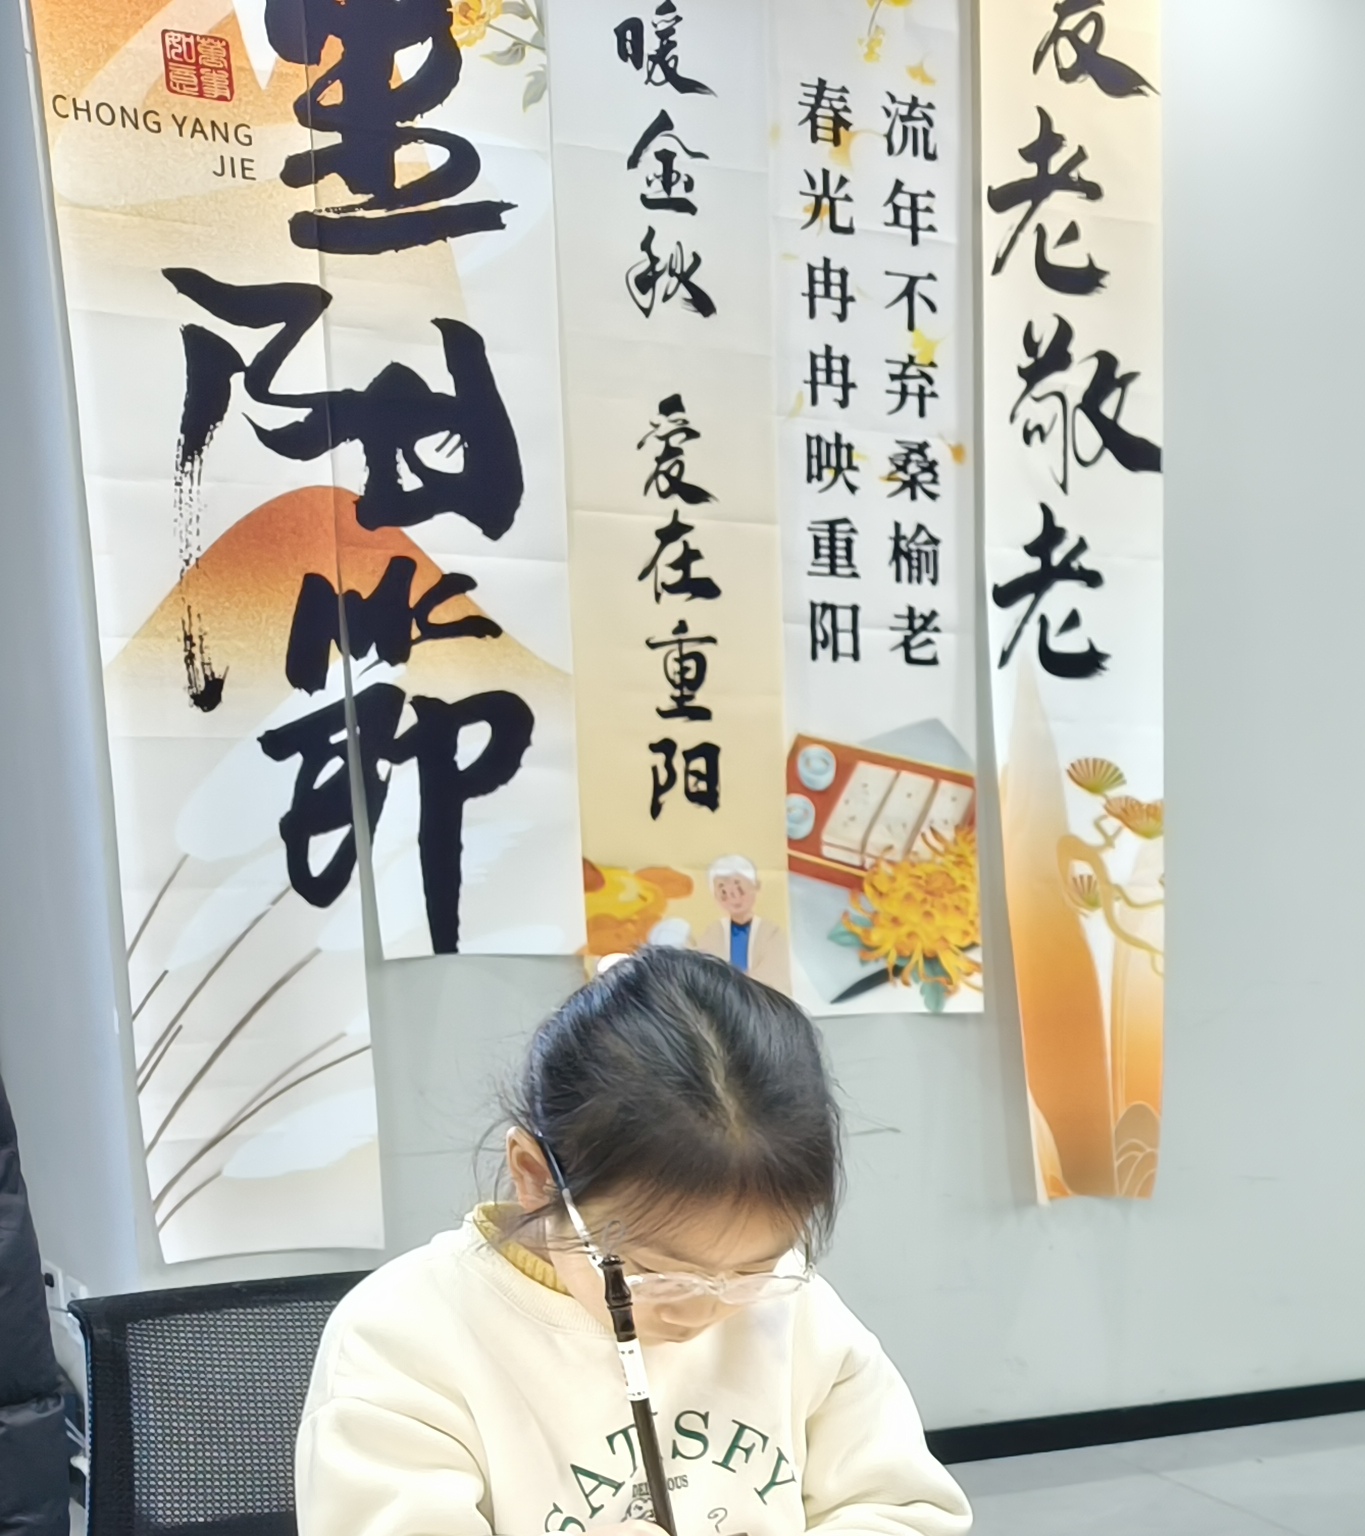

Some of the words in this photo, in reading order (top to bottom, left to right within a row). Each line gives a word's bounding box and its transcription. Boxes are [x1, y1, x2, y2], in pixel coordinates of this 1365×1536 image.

[52, 94, 162, 134] CHONG
[171, 113, 254, 147] YANG
[212, 154, 257, 181] JIE
[798, 77, 860, 662] 春光冉冉映重阳
[882, 91, 942, 666] 流年不弃桑榆老
